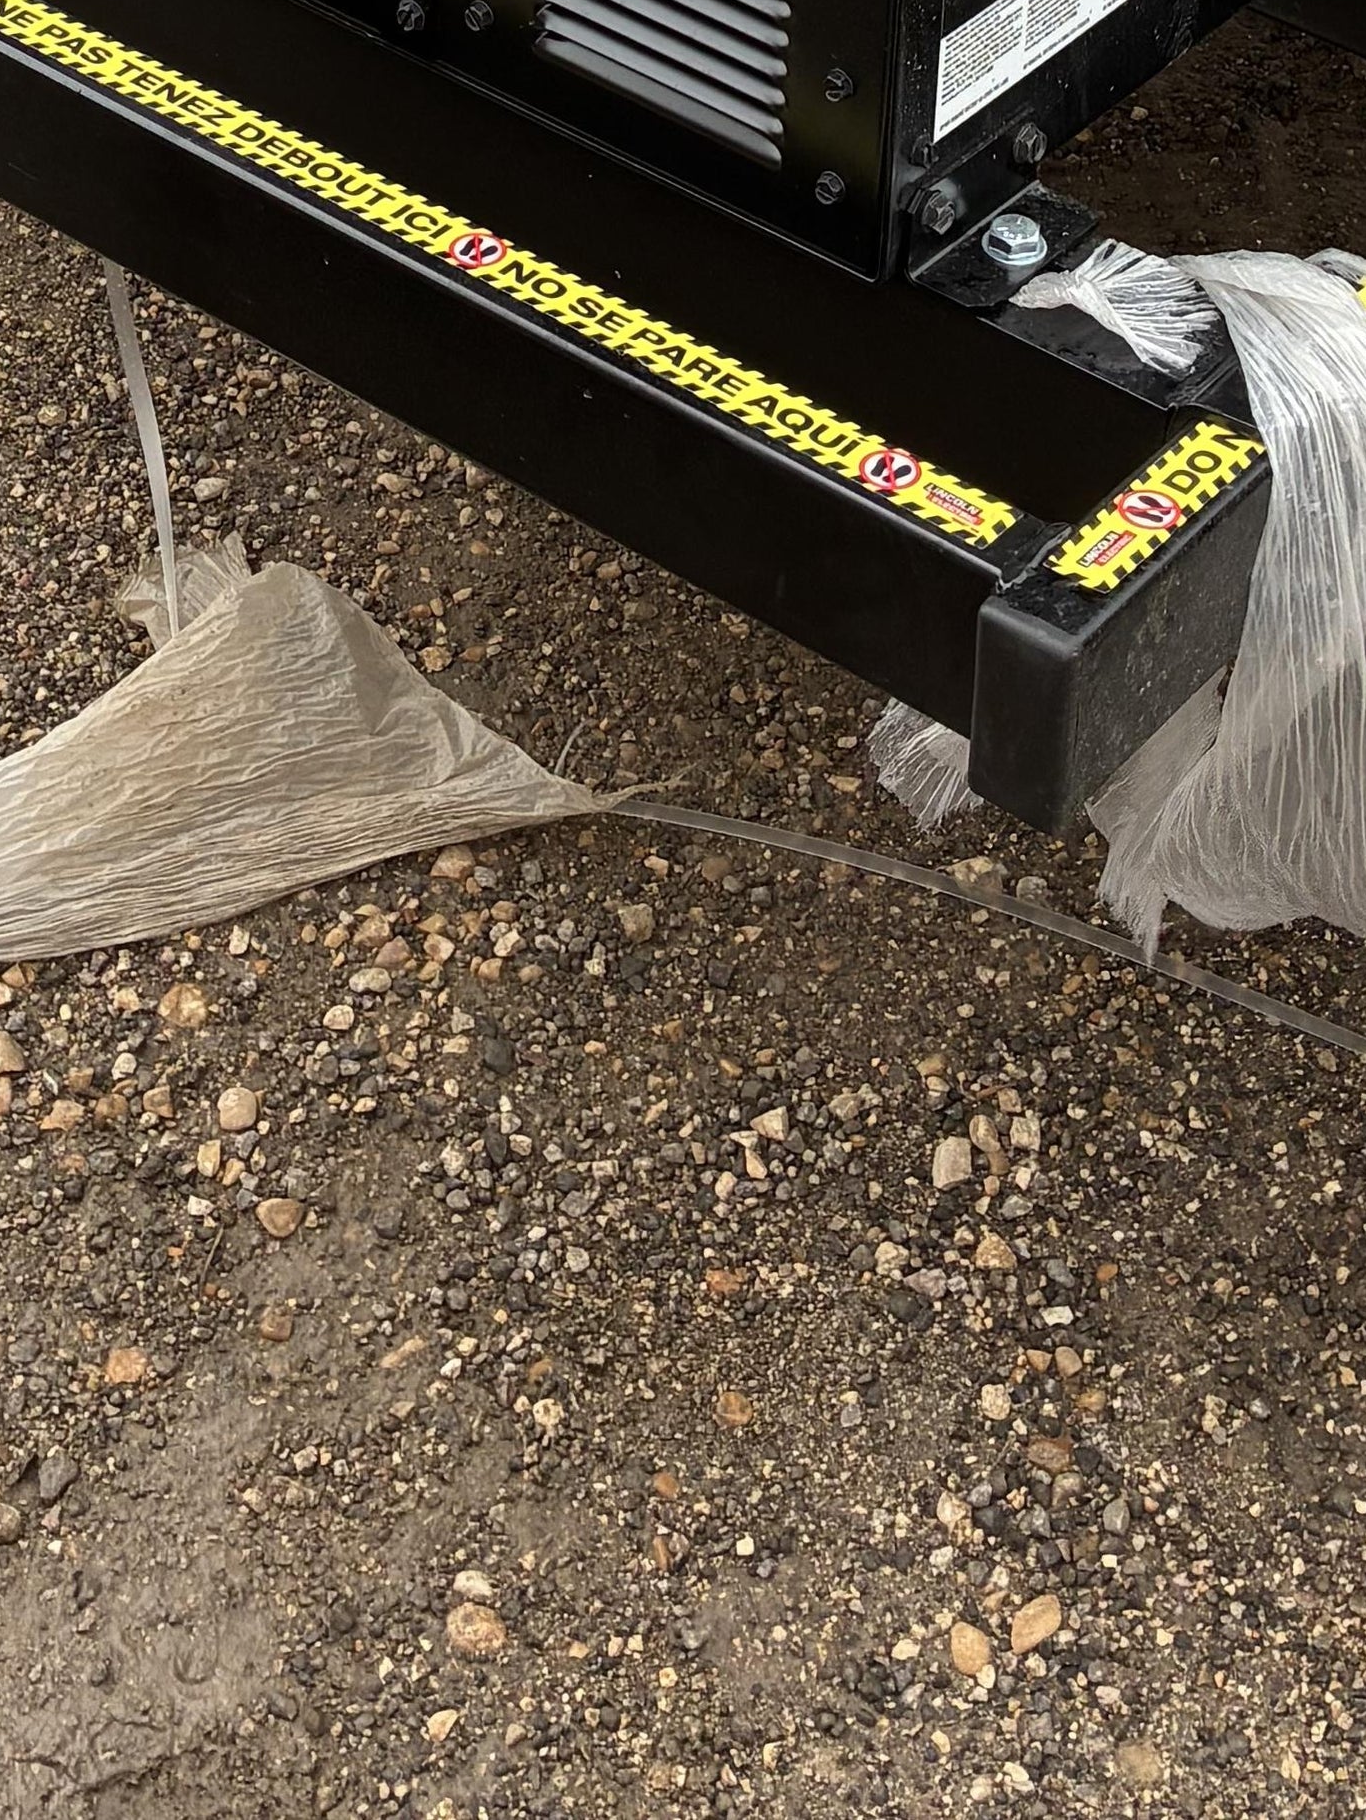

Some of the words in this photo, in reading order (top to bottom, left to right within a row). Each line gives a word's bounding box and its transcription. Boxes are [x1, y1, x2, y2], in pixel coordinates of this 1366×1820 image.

[34, 22, 112, 65] PAS
[116, 59, 237, 128] TENEZ
[234, 121, 398, 212] DEBOUT
[395, 204, 452, 239] ICI
[498, 260, 568, 299] NO
[567, 295, 633, 333] SE
[628, 327, 750, 398] PARE
[1163, 450, 1223, 495] DO
[923, 483, 981, 517] LINCOLN
[928, 494, 985, 526] ELECTRIC
[1078, 531, 1121, 567] LINCOLN
[1094, 530, 1137, 566] ELECTRIC
